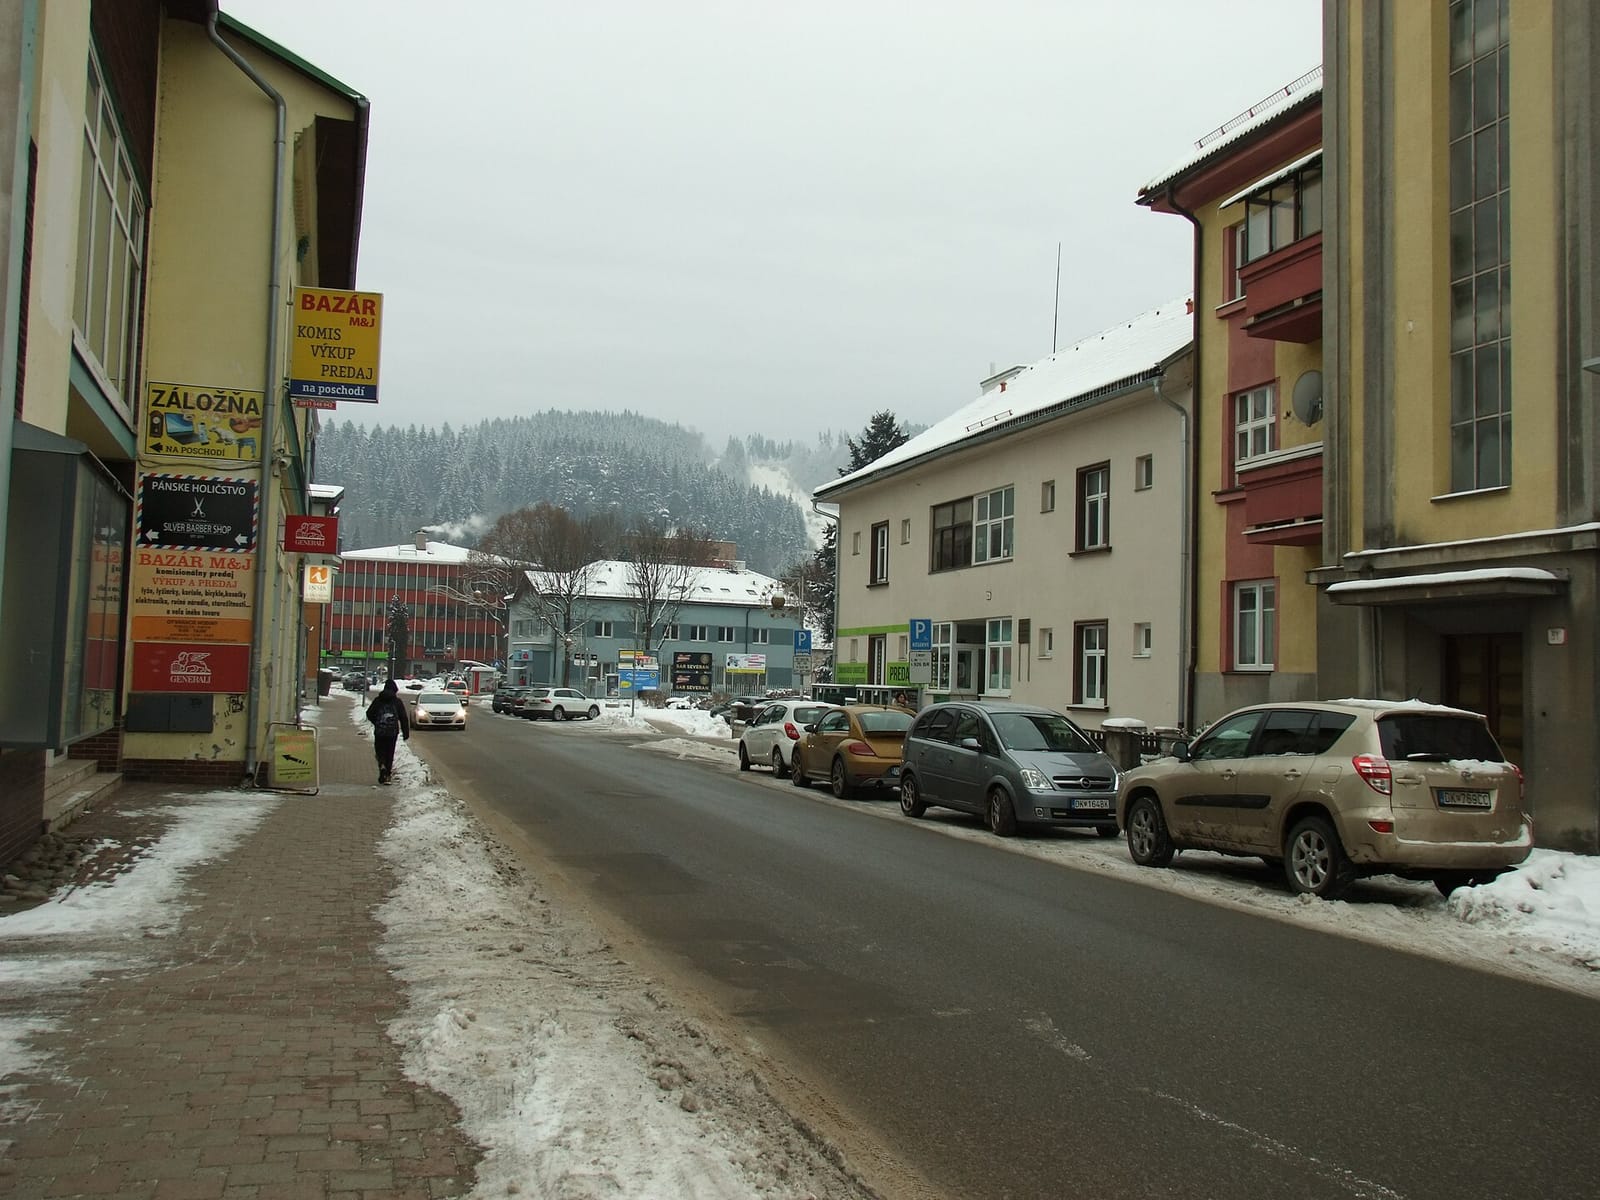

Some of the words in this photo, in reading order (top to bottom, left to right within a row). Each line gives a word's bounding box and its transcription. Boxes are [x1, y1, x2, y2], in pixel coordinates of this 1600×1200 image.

[302, 294, 376, 317] BAZÁR
[350, 317, 375, 328] M&J
[297, 325, 341, 341] KOMIS
[311, 343, 356, 360] VÝKUP
[321, 364, 373, 380] PREDAJ
[303, 384, 316, 393] na
[318, 385, 365, 396] poschodí
[152, 388, 260, 415] ZÁLOŽŇA
[181, 446, 225, 456] POSCHODÍ
[152, 480, 190, 493] PÁNSKE
[192, 482, 246, 496] HOLIČSTVO
[163, 522, 185, 533] SILVER
[186, 524, 211, 534] BARBER
[213, 526, 232, 535] SHOP
[139, 552, 203, 568] BAZÁR
[209, 557, 253, 570] M&J
[210, 570, 234, 579] predaj
[152, 577, 186, 587] VÝKUP
[188, 579, 196, 587] A
[199, 579, 237, 589] PREDAJ
[916, 621, 926, 640] P
[170, 675, 211, 684] GENERALI
[890, 666, 910, 681] PREDA
